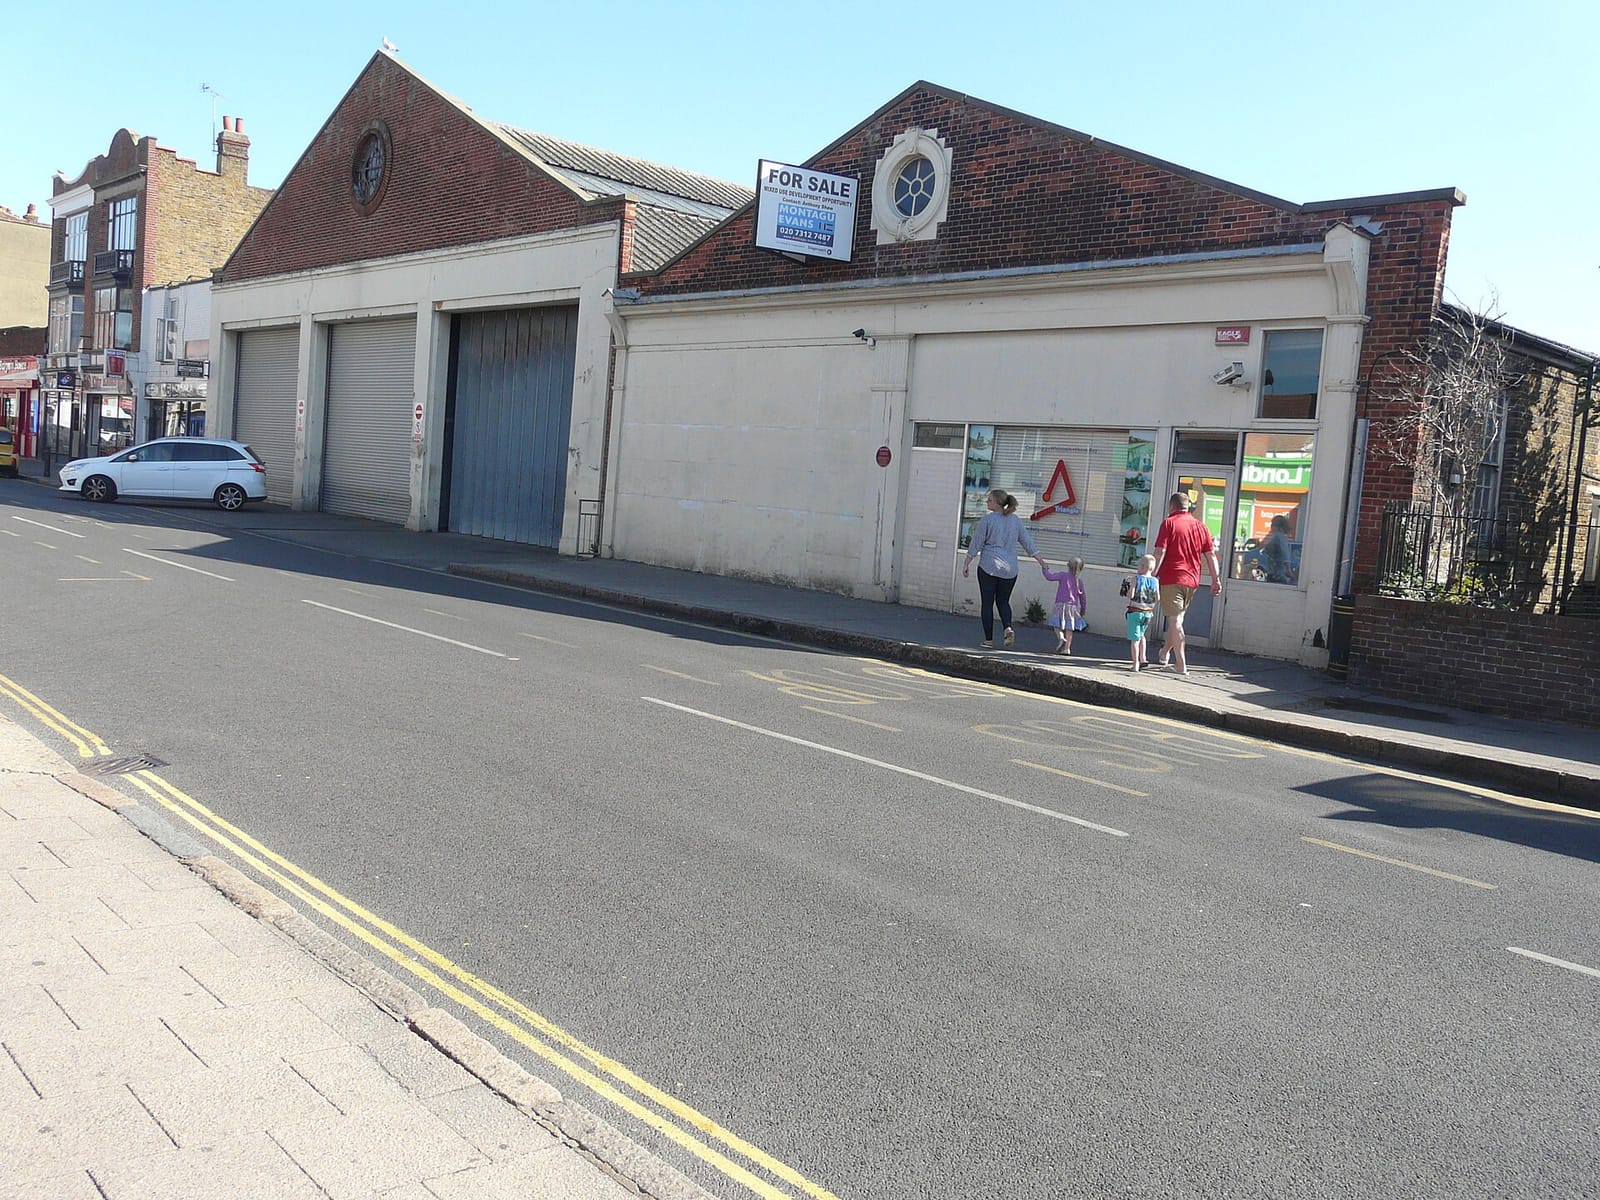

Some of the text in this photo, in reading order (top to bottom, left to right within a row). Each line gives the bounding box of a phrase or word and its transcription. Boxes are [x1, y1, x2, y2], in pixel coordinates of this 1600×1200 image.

[769, 169, 850, 198] FOR SALE
[788, 190, 821, 202] DEVELOPMENT
[821, 196, 853, 208] OPPORTUNITY
[778, 204, 835, 221] MONTAGU
[778, 214, 814, 229] EVANS
[780, 226, 793, 235] 020
[795, 228, 813, 239] 7312
[742, 667, 1006, 705] STOP
[973, 716, 1266, 773] BUS
